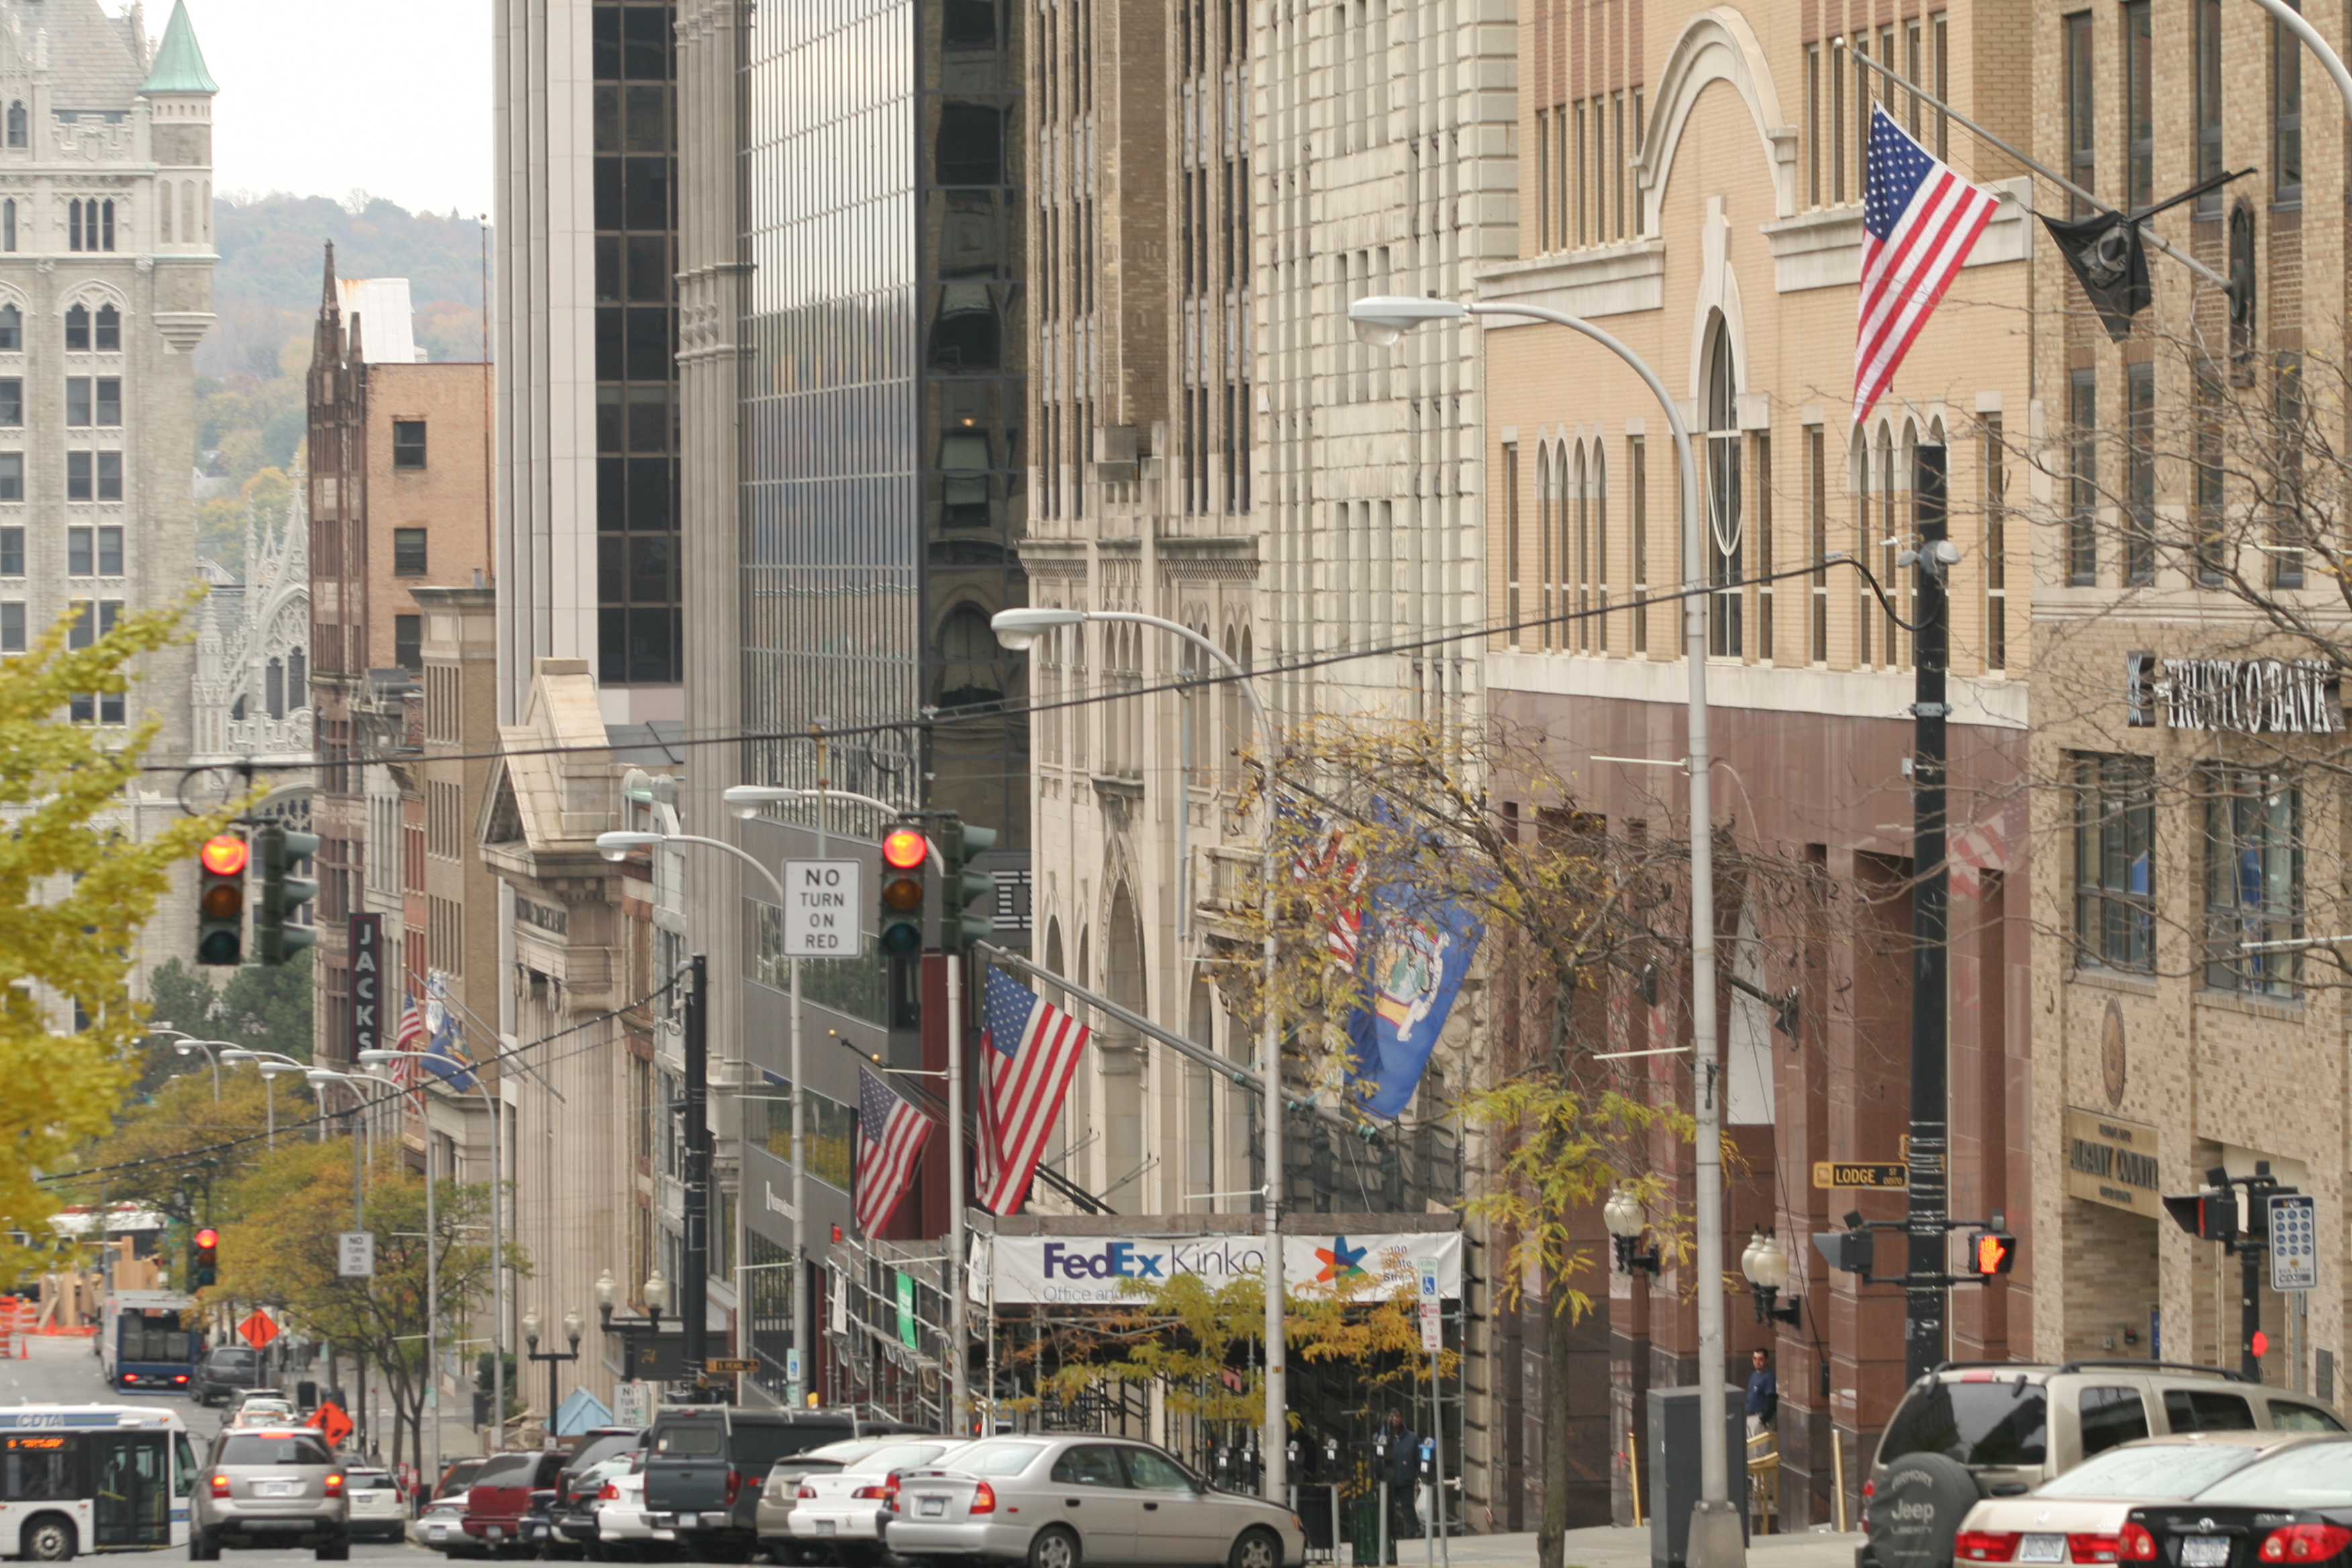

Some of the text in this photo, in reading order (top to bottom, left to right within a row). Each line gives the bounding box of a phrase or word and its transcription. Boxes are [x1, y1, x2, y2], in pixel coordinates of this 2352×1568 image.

[2163, 658, 2332, 734] TRUSTCO BANK
[806, 869, 839, 886] NO
[800, 893, 844, 907] TURN
[810, 914, 834, 927] ON
[805, 934, 838, 948] RED
[354, 924, 376, 1050] JACKS
[1835, 1168, 1876, 1183] LODGE
[1044, 1242, 1165, 1279] FedEx
[1171, 1242, 1286, 1276] Kinko
[1383, 1272, 1412, 1281] Stree
[1044, 1285, 1093, 1302] Office
[18, 1414, 64, 1427] CDTA
[1891, 1498, 1934, 1524] Jeep
